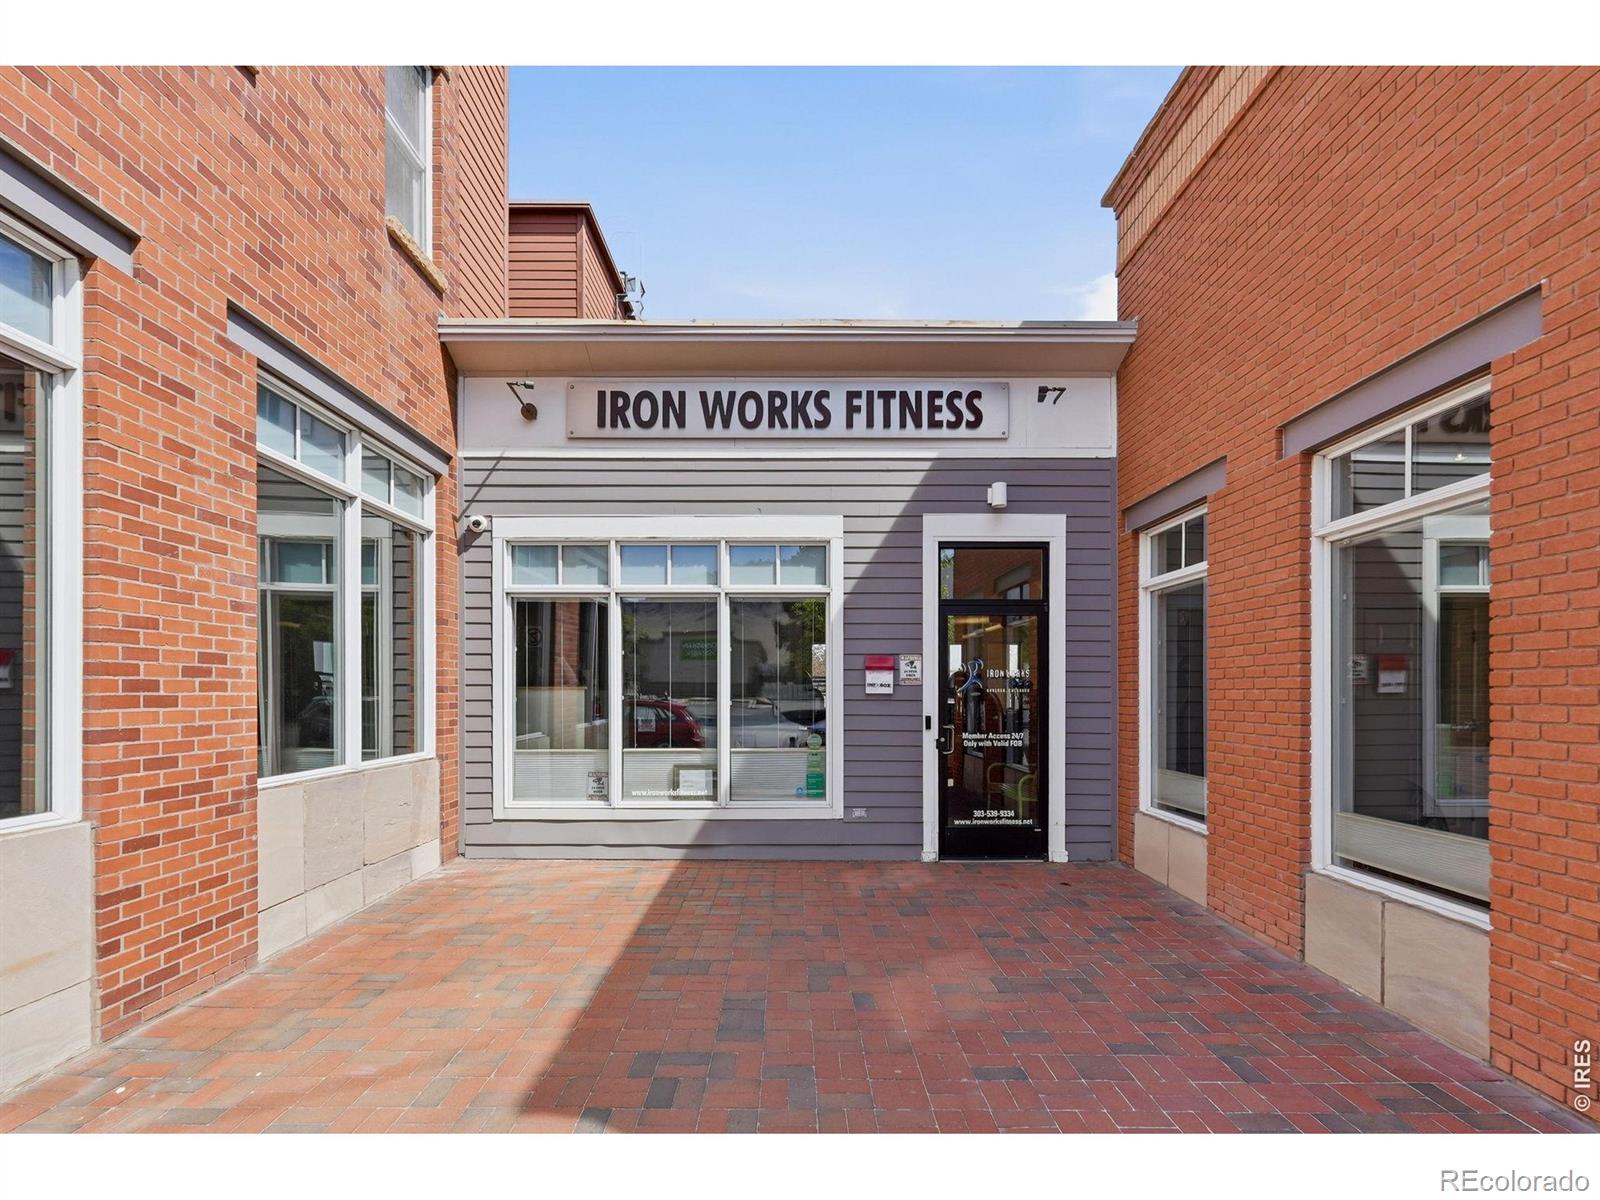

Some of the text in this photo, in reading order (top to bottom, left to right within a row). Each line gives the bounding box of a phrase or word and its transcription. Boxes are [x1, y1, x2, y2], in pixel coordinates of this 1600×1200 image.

[596, 390, 984, 430] IRON WORKS FITNESS
[986, 669, 1005, 678] IRON
